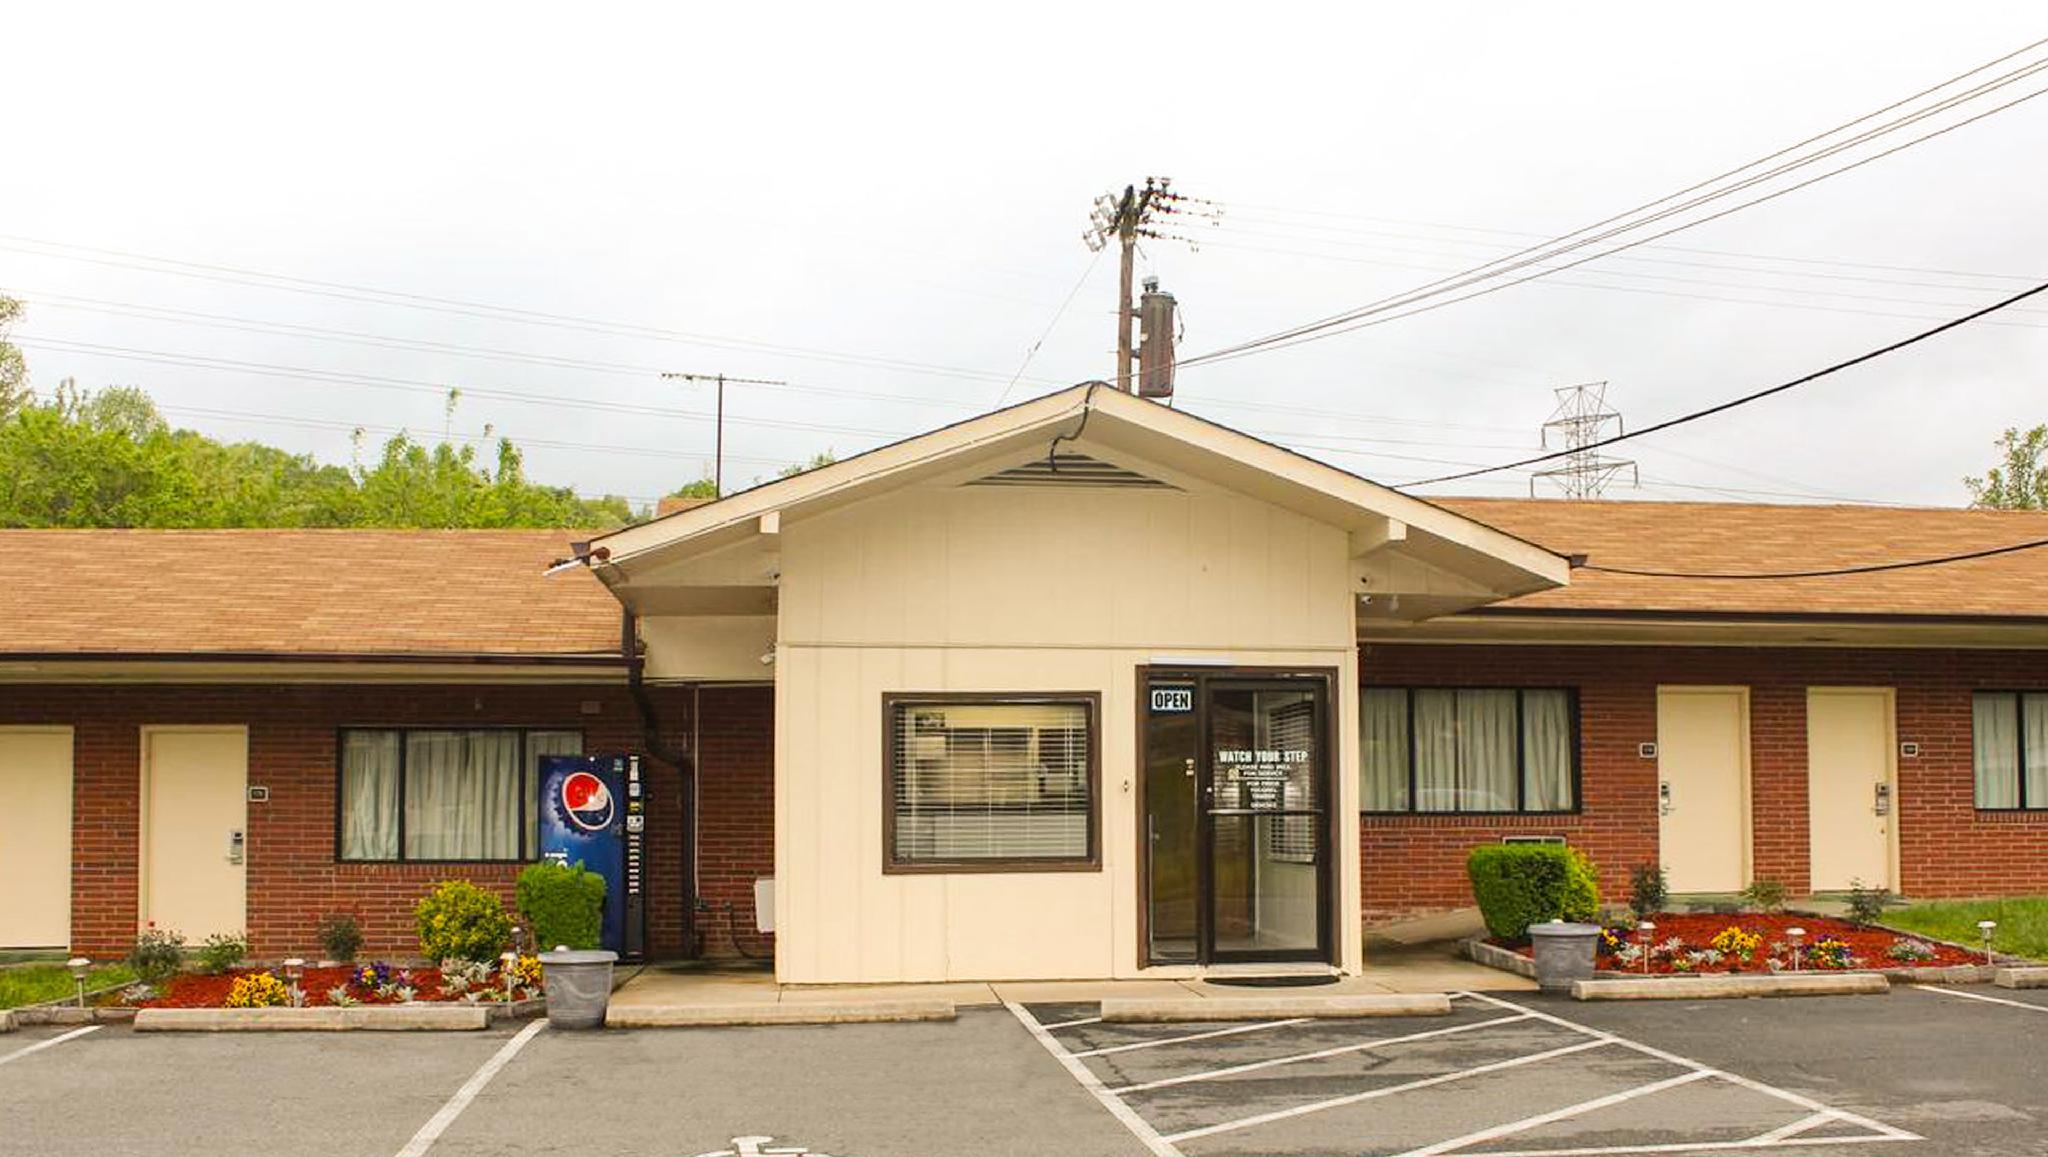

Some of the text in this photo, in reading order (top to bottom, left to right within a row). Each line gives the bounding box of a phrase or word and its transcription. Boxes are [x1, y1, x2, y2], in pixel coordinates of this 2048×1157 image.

[1155, 692, 1189, 708] OPEN
[1219, 750, 1308, 762] WATCH YOUR STEP
